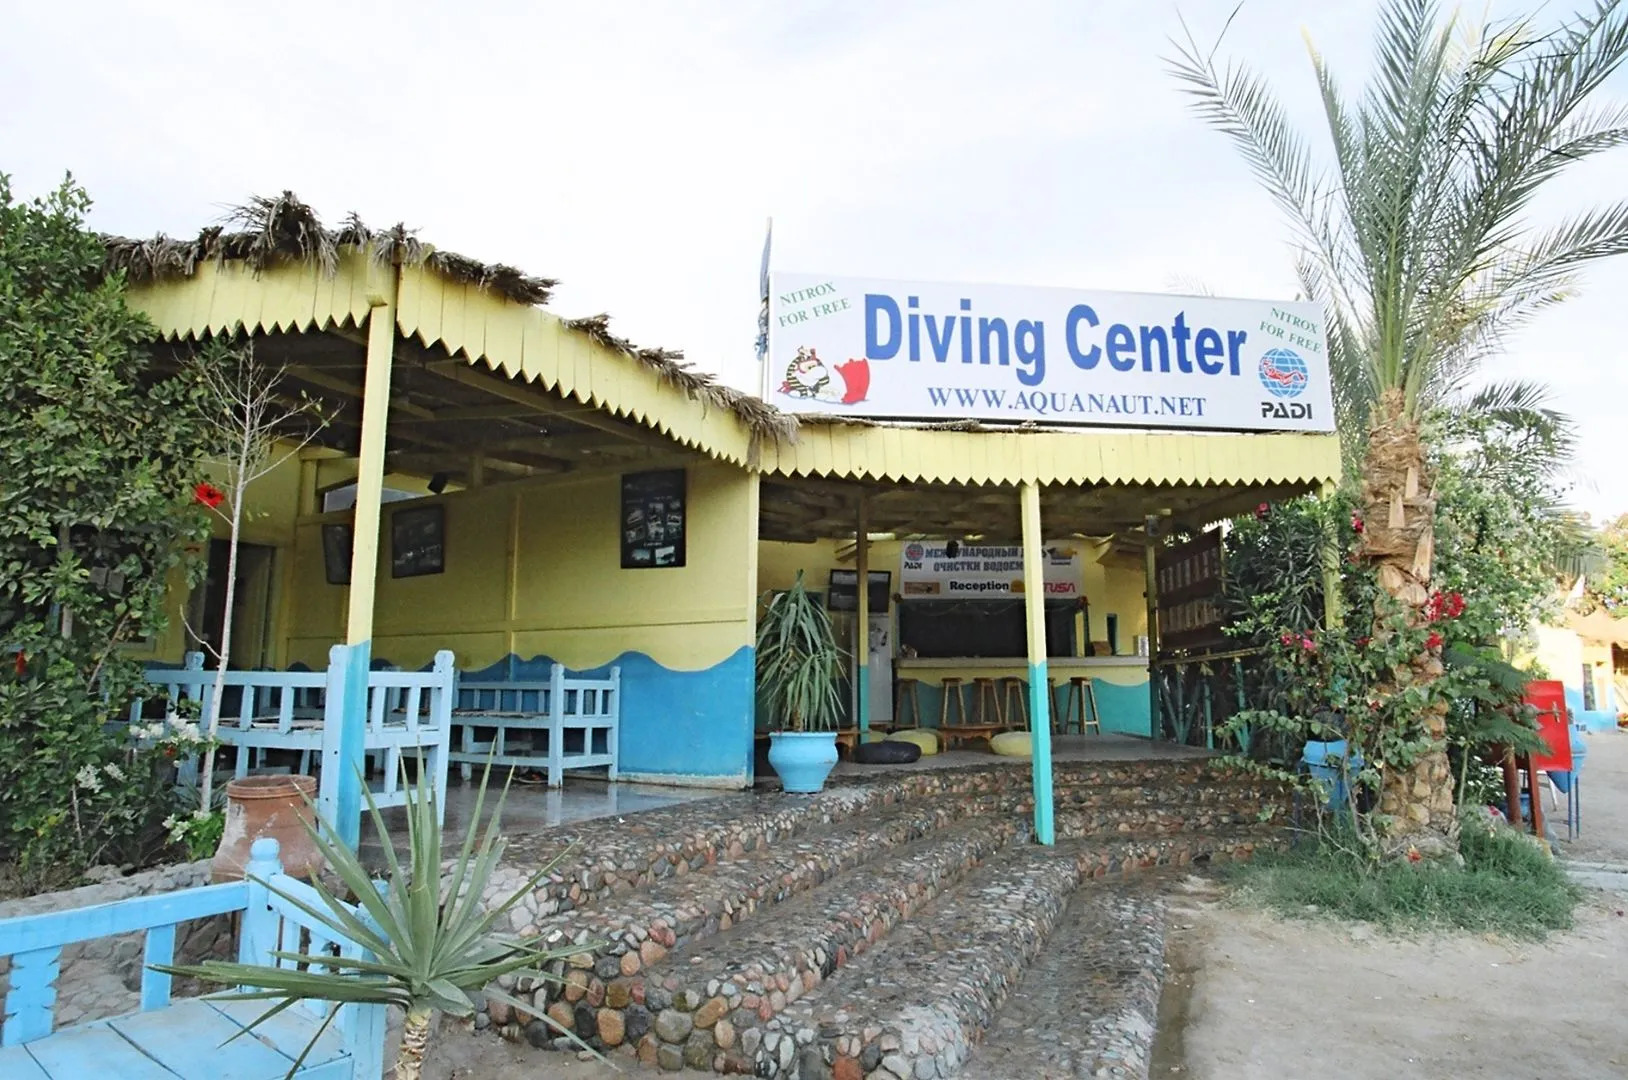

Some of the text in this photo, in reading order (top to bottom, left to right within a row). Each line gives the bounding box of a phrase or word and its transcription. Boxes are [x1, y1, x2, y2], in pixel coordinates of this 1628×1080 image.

[779, 281, 837, 306] NITROX
[778, 297, 852, 328] FOR FREE
[1270, 306, 1319, 334] NITROX
[864, 293, 1247, 387] Diving Center
[1259, 320, 1322, 354] FOR FREE
[927, 387, 1207, 417] WWW.AQUANAUT.NET
[1260, 402, 1313, 420] PADI
[925, 548, 1018, 558] МЕЖУНАРОДНЫЙ
[950, 580, 1009, 592] Reception
